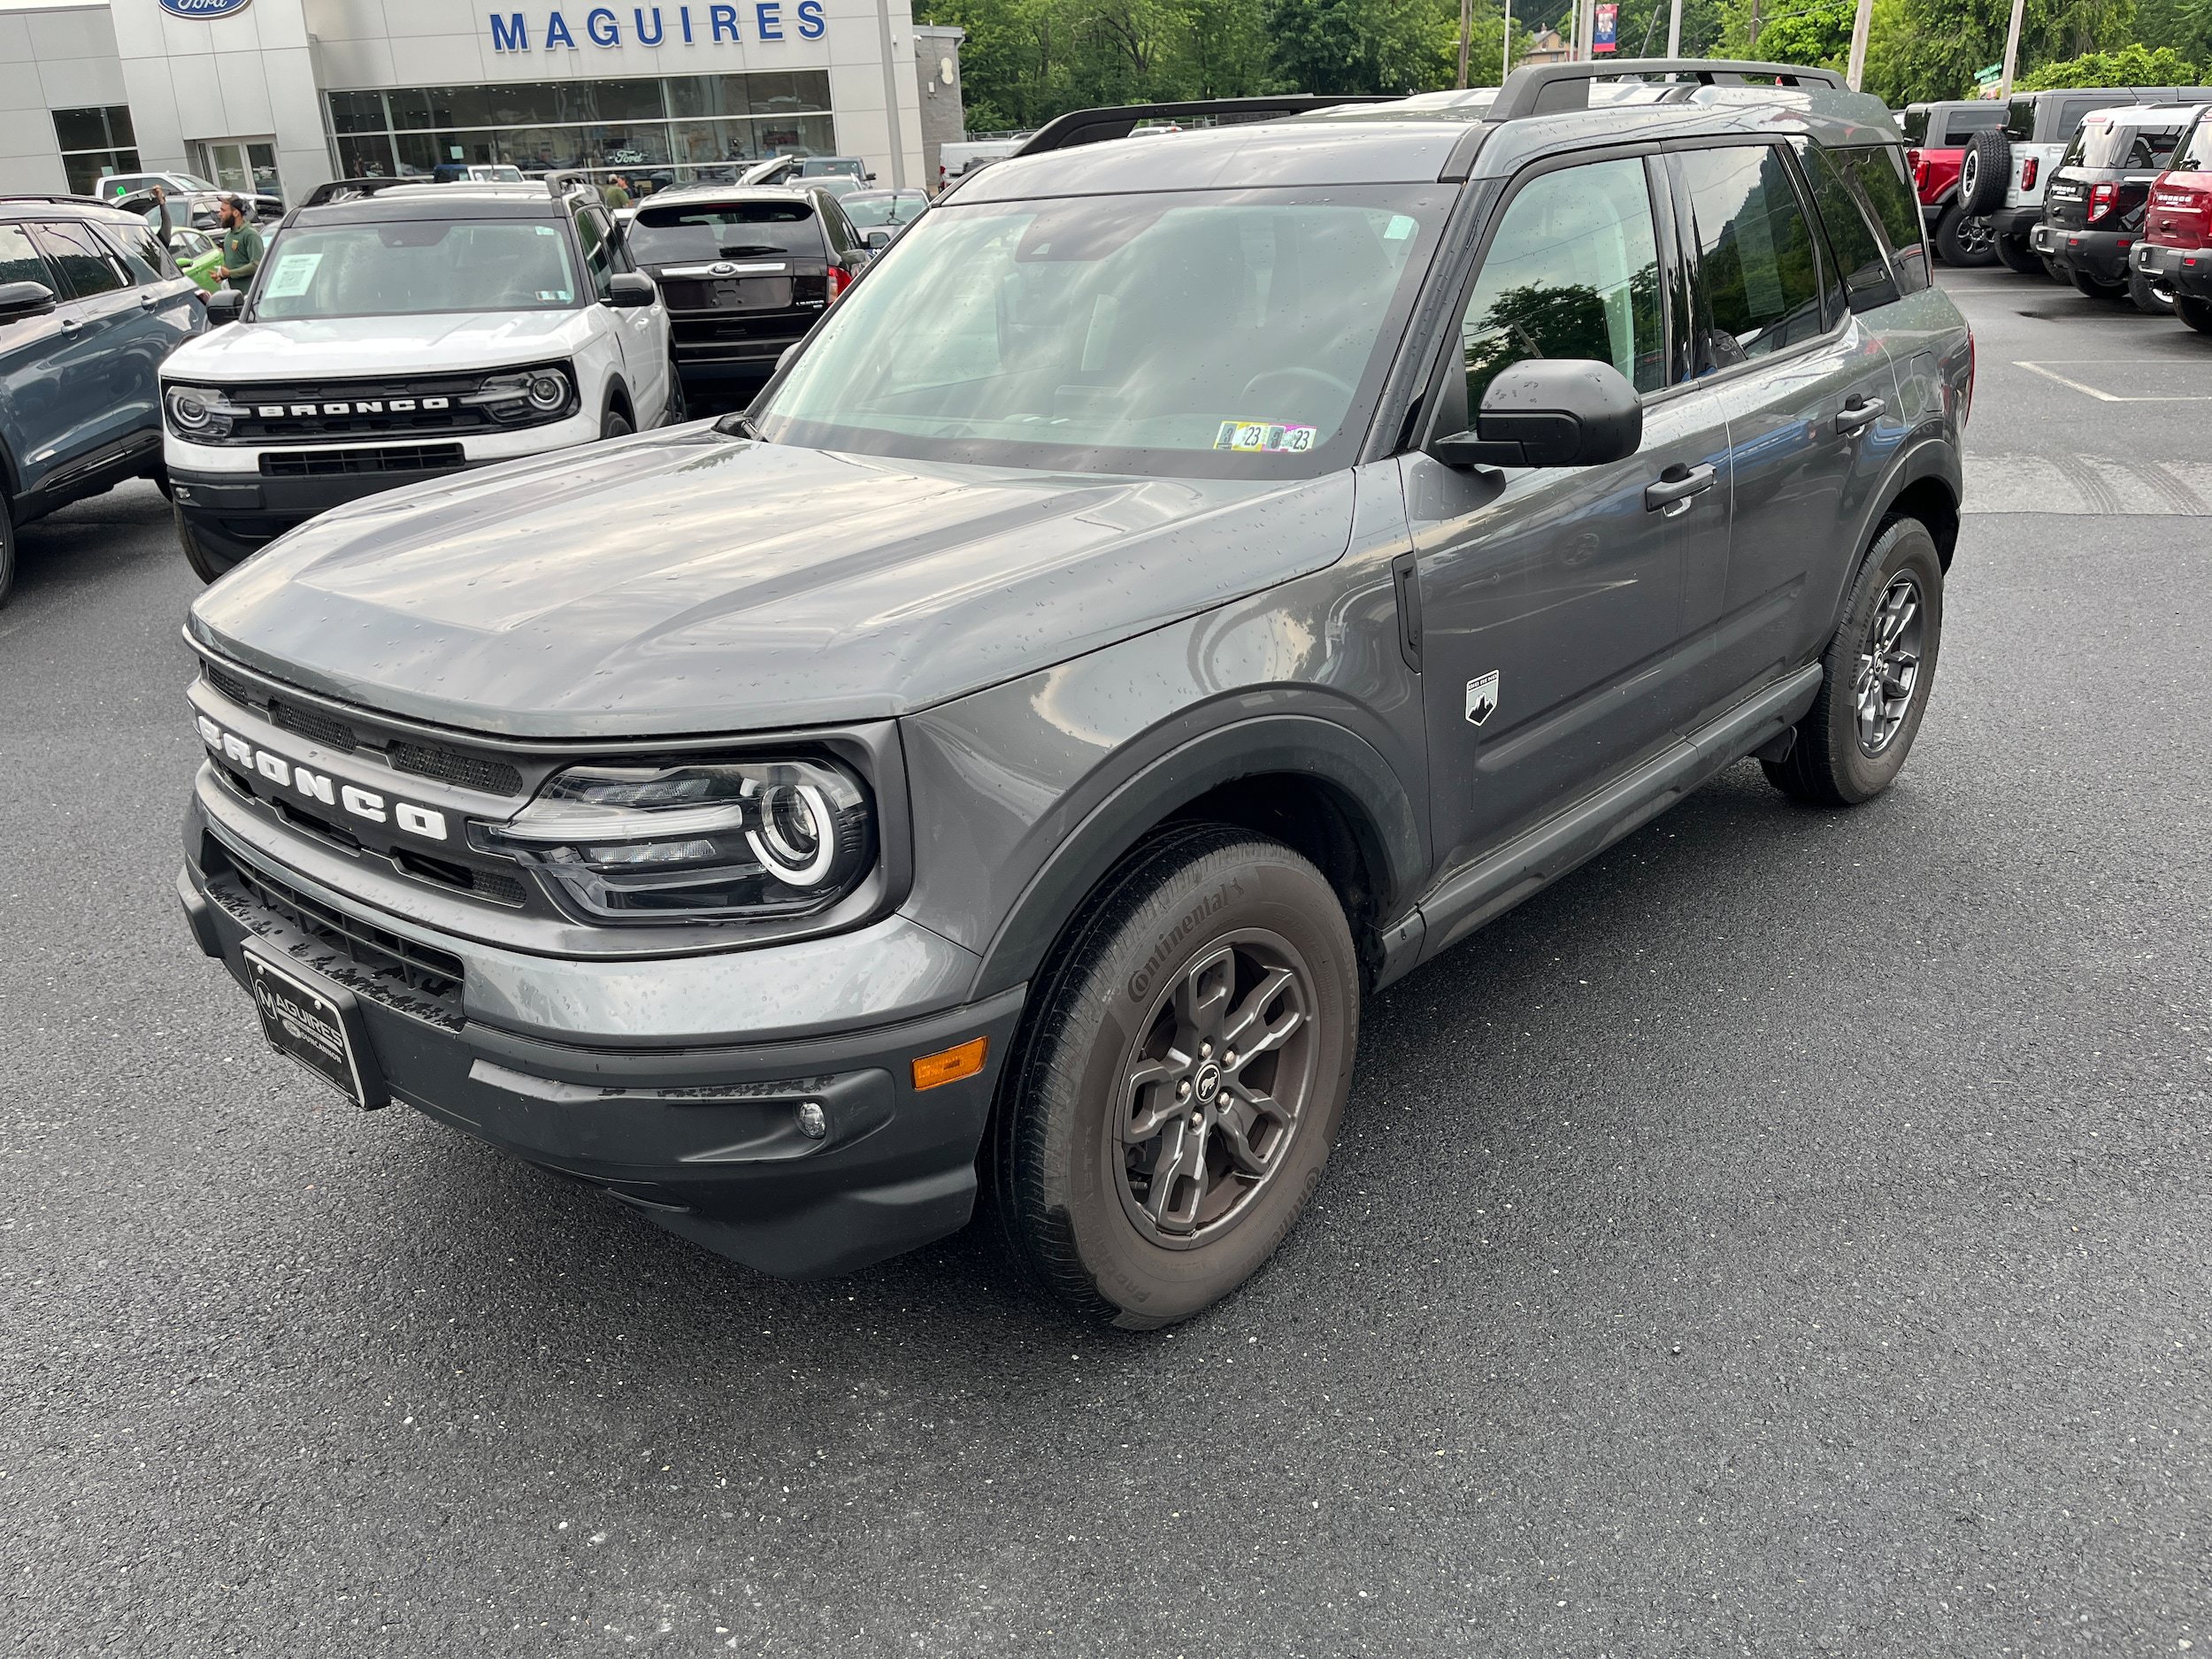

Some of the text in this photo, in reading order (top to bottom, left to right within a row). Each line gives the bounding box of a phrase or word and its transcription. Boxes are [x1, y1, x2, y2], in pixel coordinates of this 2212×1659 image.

[488, 0, 827, 53] MAGUIRES
[614, 150, 644, 164] Ford
[257, 396, 449, 418] BRONCO
[1244, 426, 1262, 447] 23
[1293, 429, 1310, 450] 23
[197, 715, 449, 841] BRONCO
[1126, 887, 1230, 1004] Continental
